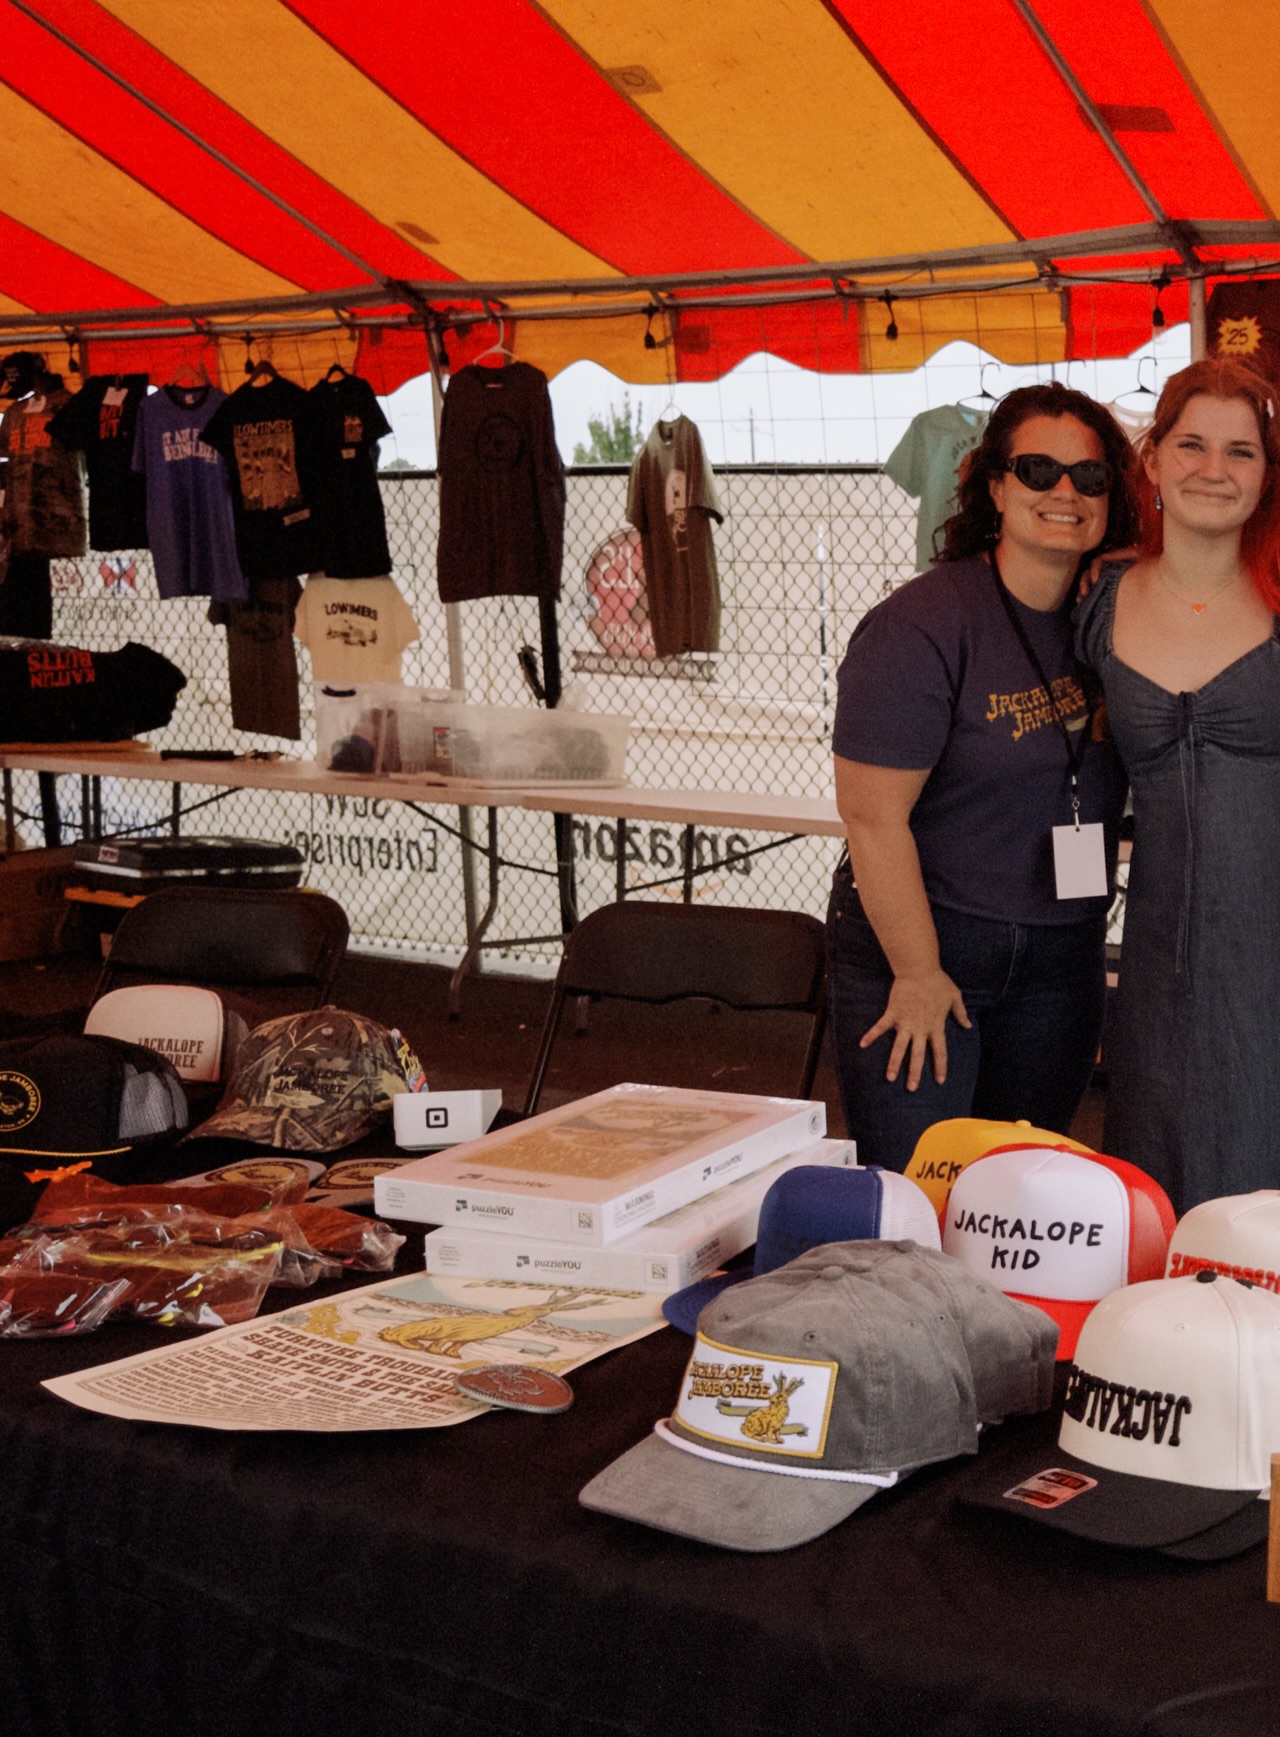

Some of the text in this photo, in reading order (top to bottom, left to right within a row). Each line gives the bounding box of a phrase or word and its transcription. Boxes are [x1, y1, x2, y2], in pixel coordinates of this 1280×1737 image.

[138, 1037, 204, 1055] JACKALOPE
[275, 1064, 350, 1083] JACKALOPE
[10, 1075, 37, 1112] JAMBOREE
[273, 1080, 346, 1096] JAMBOREE
[471, 1203, 515, 1217] puzzleYOU
[954, 1210, 1103, 1248] JACKALOPE
[533, 1259, 582, 1272] puzzleYOU
[990, 1245, 1041, 1271] KID
[263, 1325, 365, 1360] TURNPIKE
[241, 1332, 307, 1359] SHANE
[301, 1352, 362, 1374] SMITH
[379, 1371, 423, 1387] THE
[245, 1349, 445, 1404] KAITLIN BUTTS
